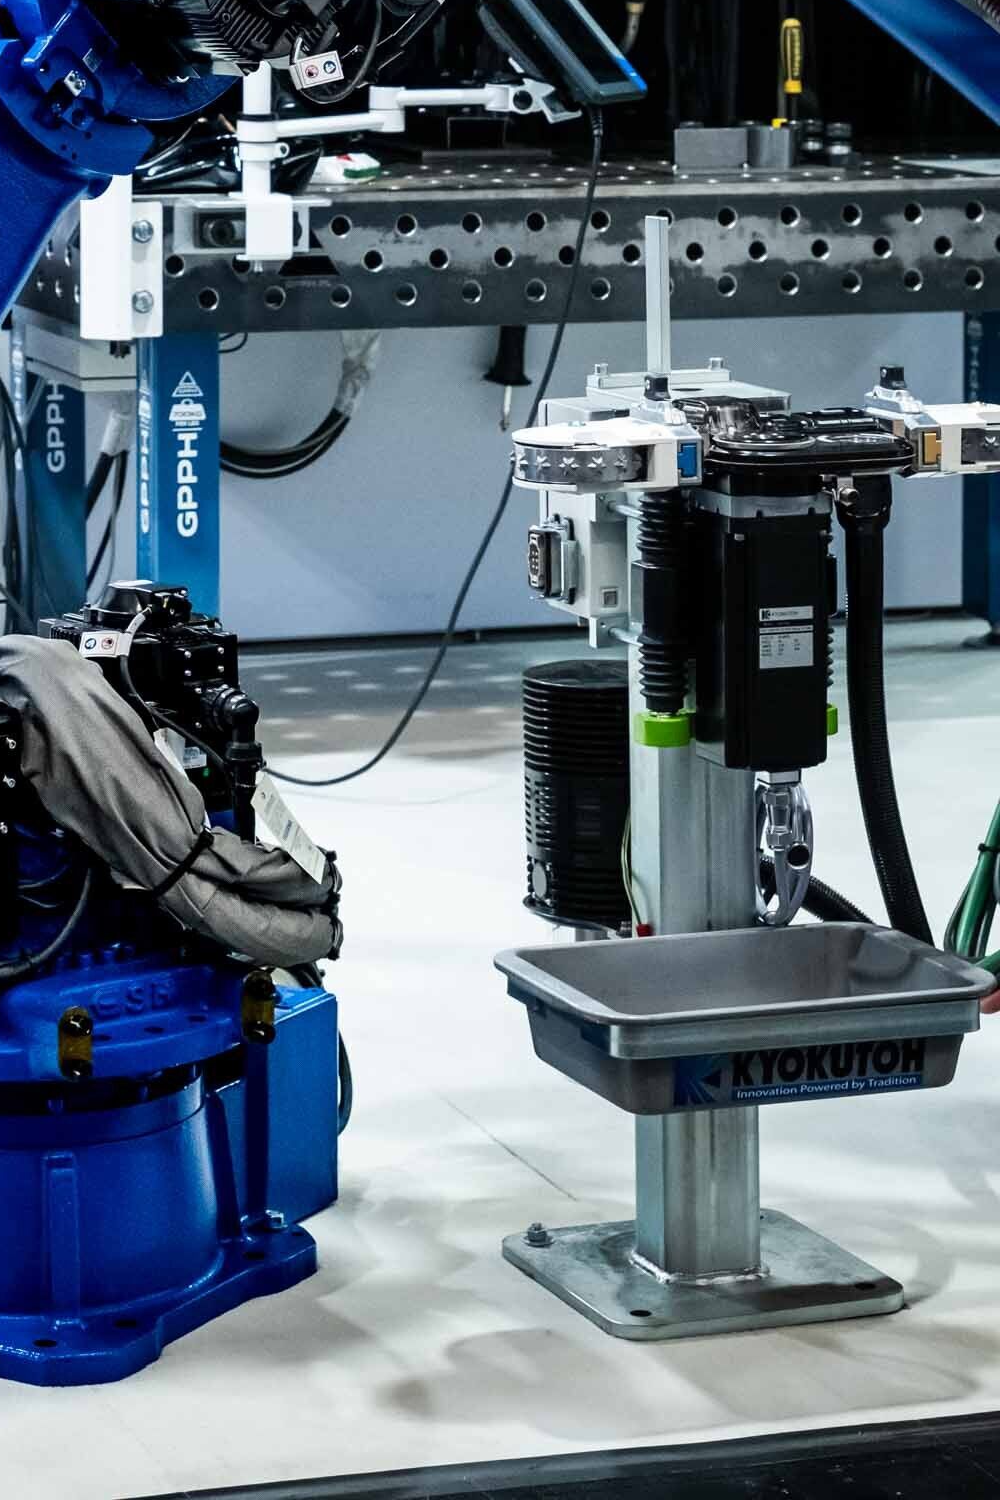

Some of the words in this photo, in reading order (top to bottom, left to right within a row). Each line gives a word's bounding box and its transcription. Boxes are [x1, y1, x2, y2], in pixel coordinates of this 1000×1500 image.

[47, 380, 65, 473] GPPH
[177, 432, 198, 538] GPPH
[731, 1037, 927, 1088] KYOKUTOH
[736, 1087, 798, 1098] Innovation
[800, 1080, 849, 1093] Powered
[851, 1079, 866, 1090] by
[868, 1075, 917, 1086] Tradition
